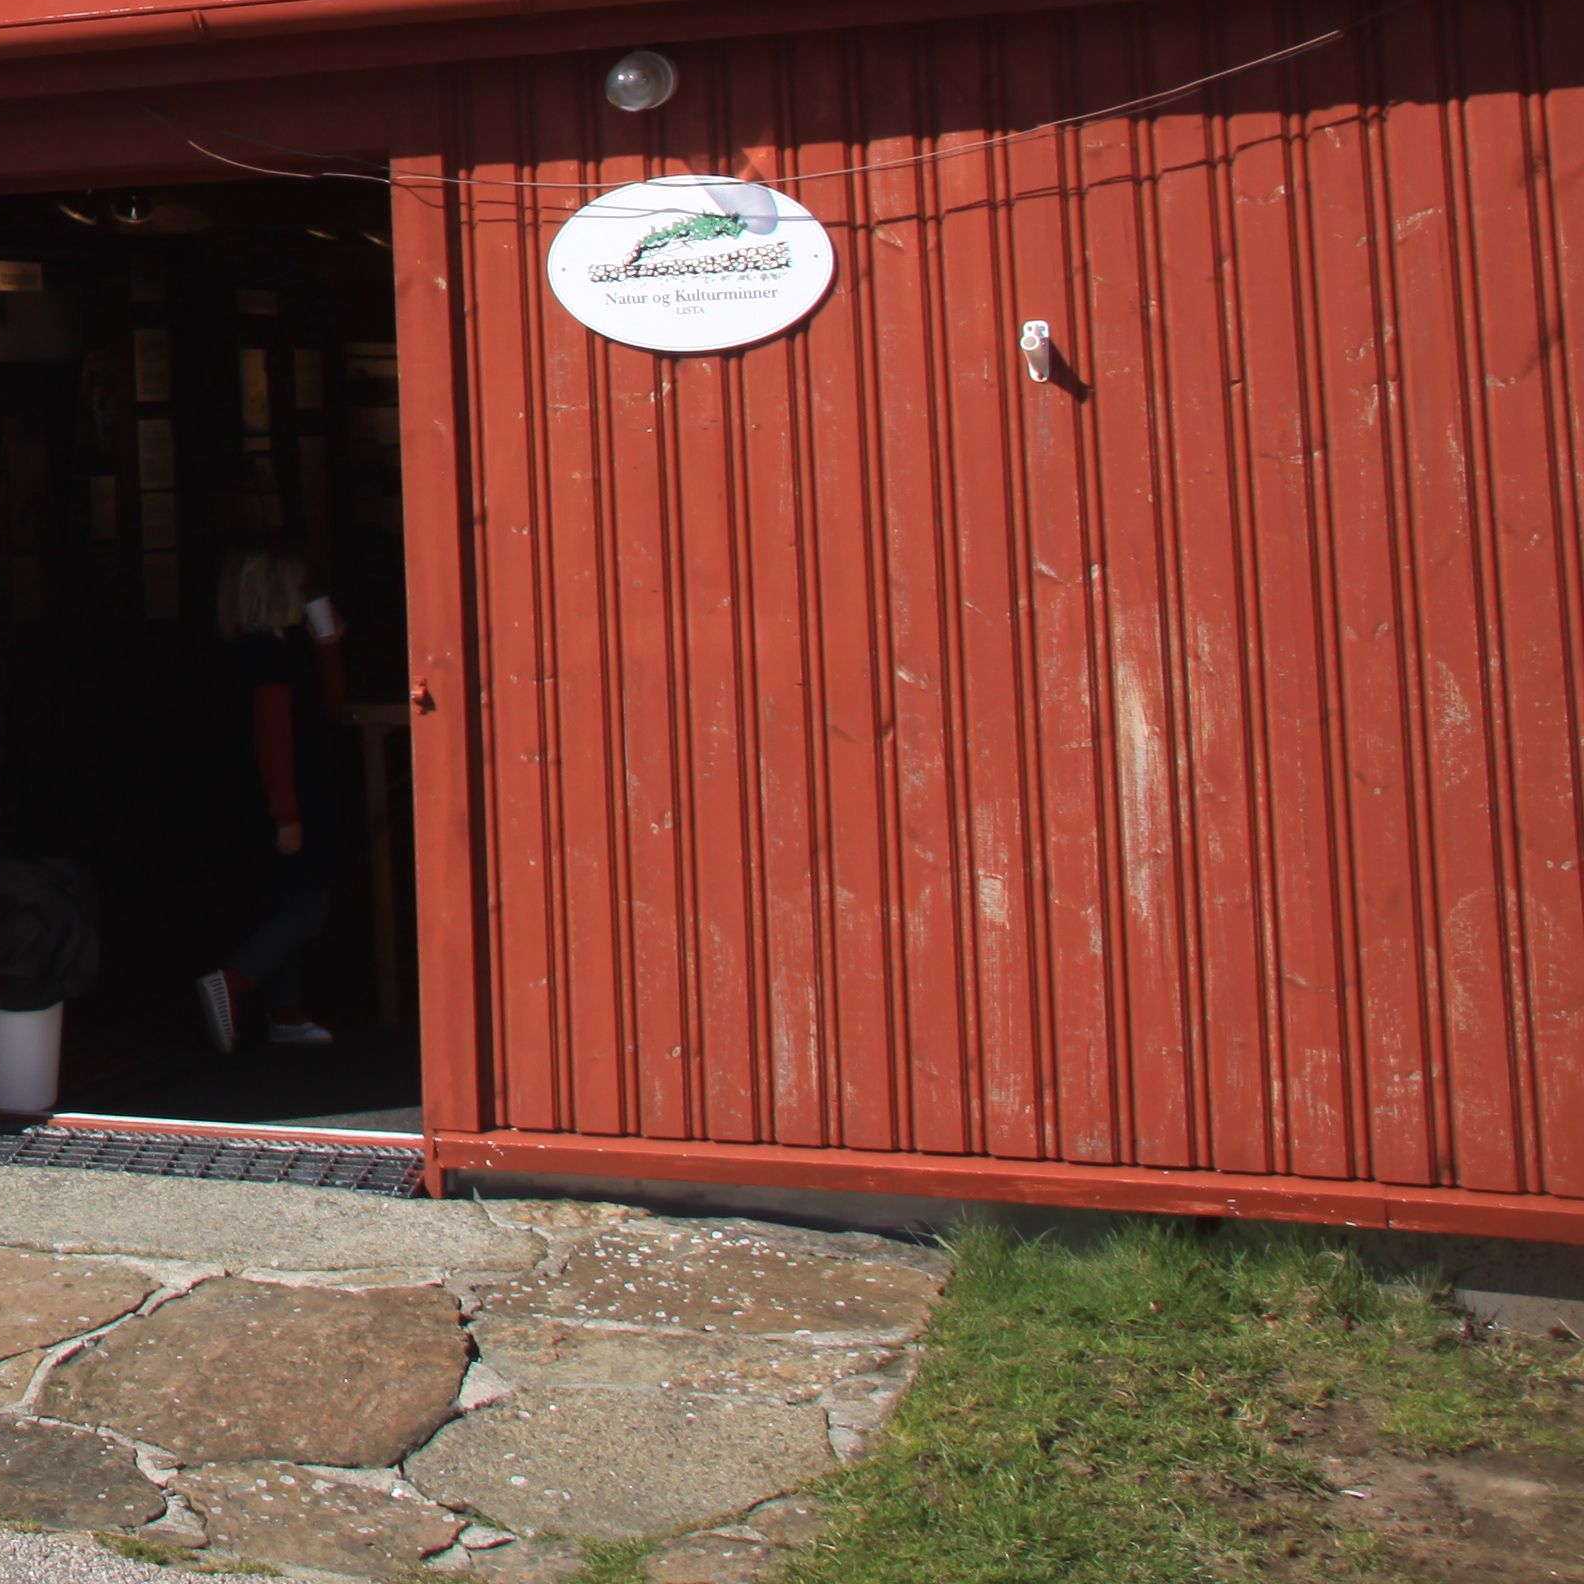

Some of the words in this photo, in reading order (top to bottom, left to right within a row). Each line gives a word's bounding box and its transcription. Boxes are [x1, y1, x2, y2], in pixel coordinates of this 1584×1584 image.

[604, 291, 648, 306] Natur
[652, 293, 671, 307] og
[674, 287, 779, 304] Kulturminner
